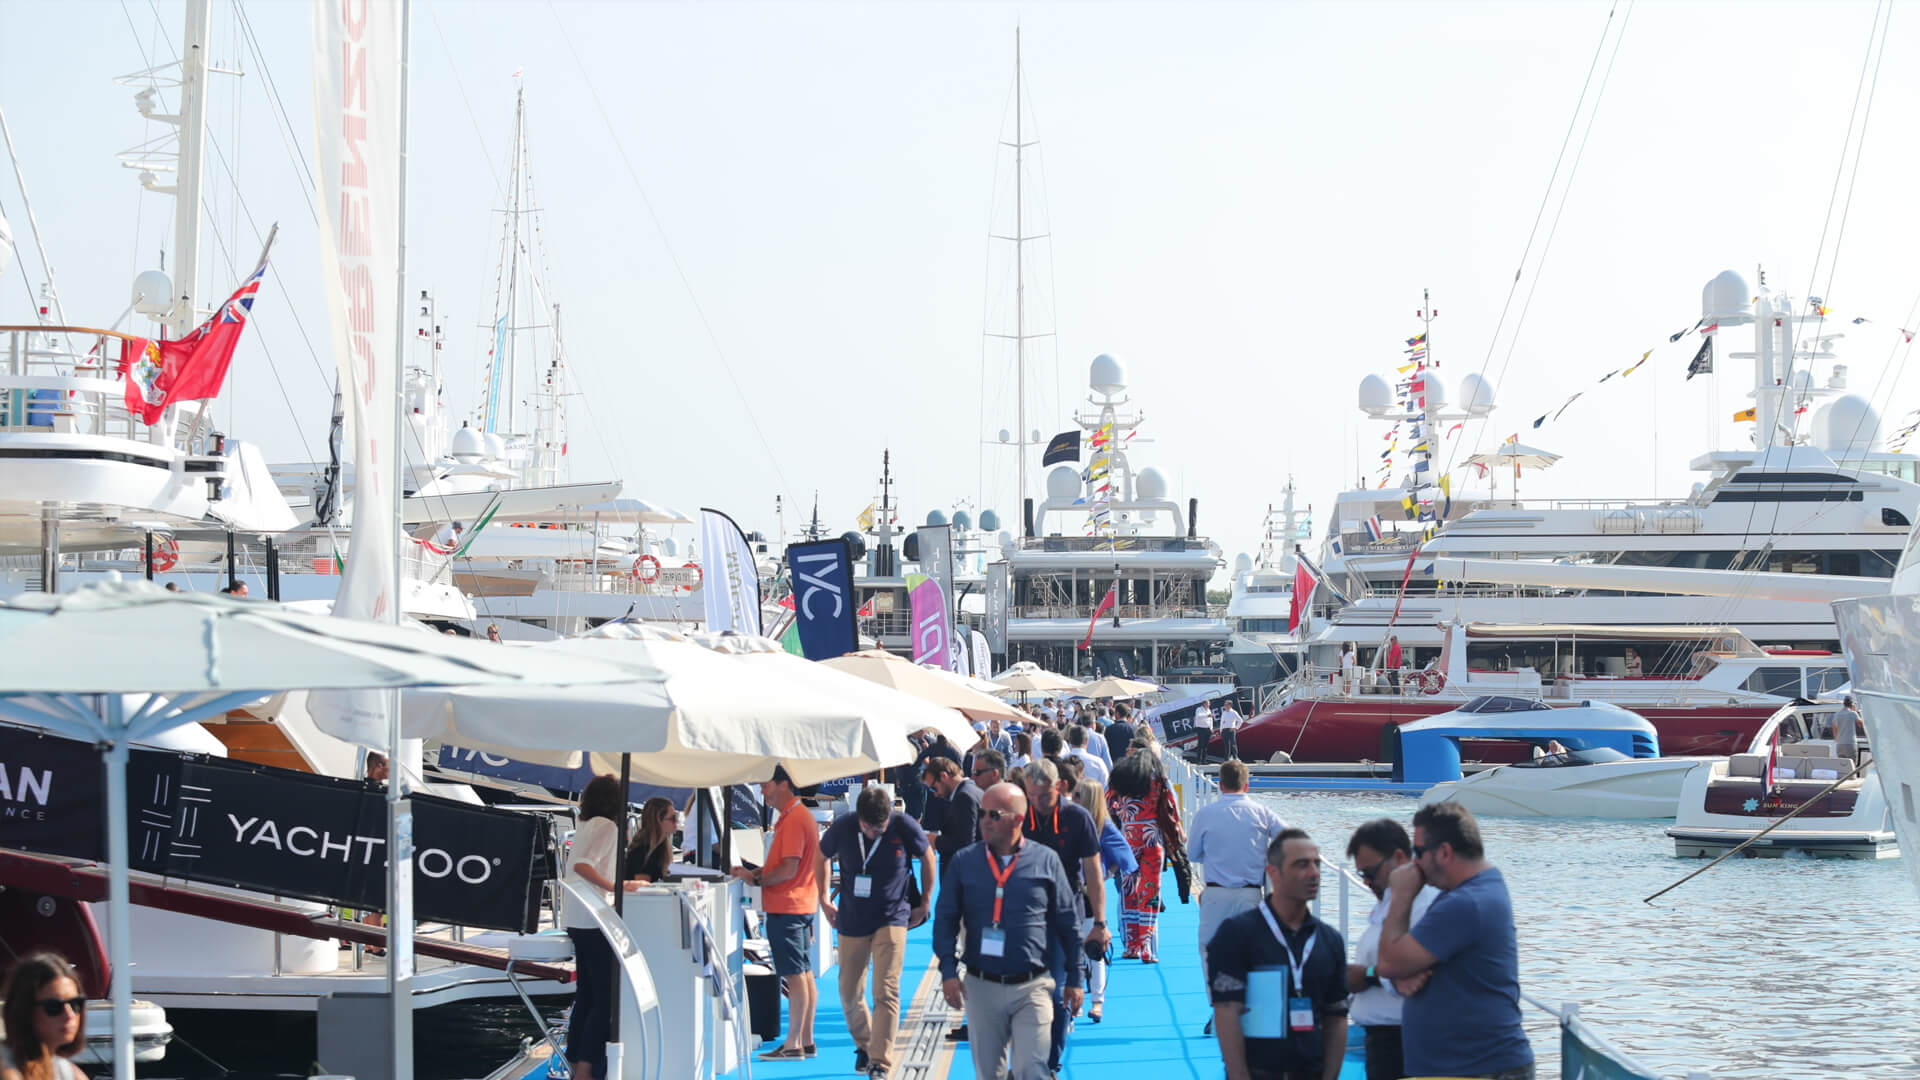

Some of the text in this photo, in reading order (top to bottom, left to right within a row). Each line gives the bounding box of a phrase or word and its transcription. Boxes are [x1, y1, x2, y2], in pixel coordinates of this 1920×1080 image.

[797, 553, 842, 620] IYC
[1172, 708, 1224, 733] FRE
[228, 813, 502, 884] YACHTOO®
